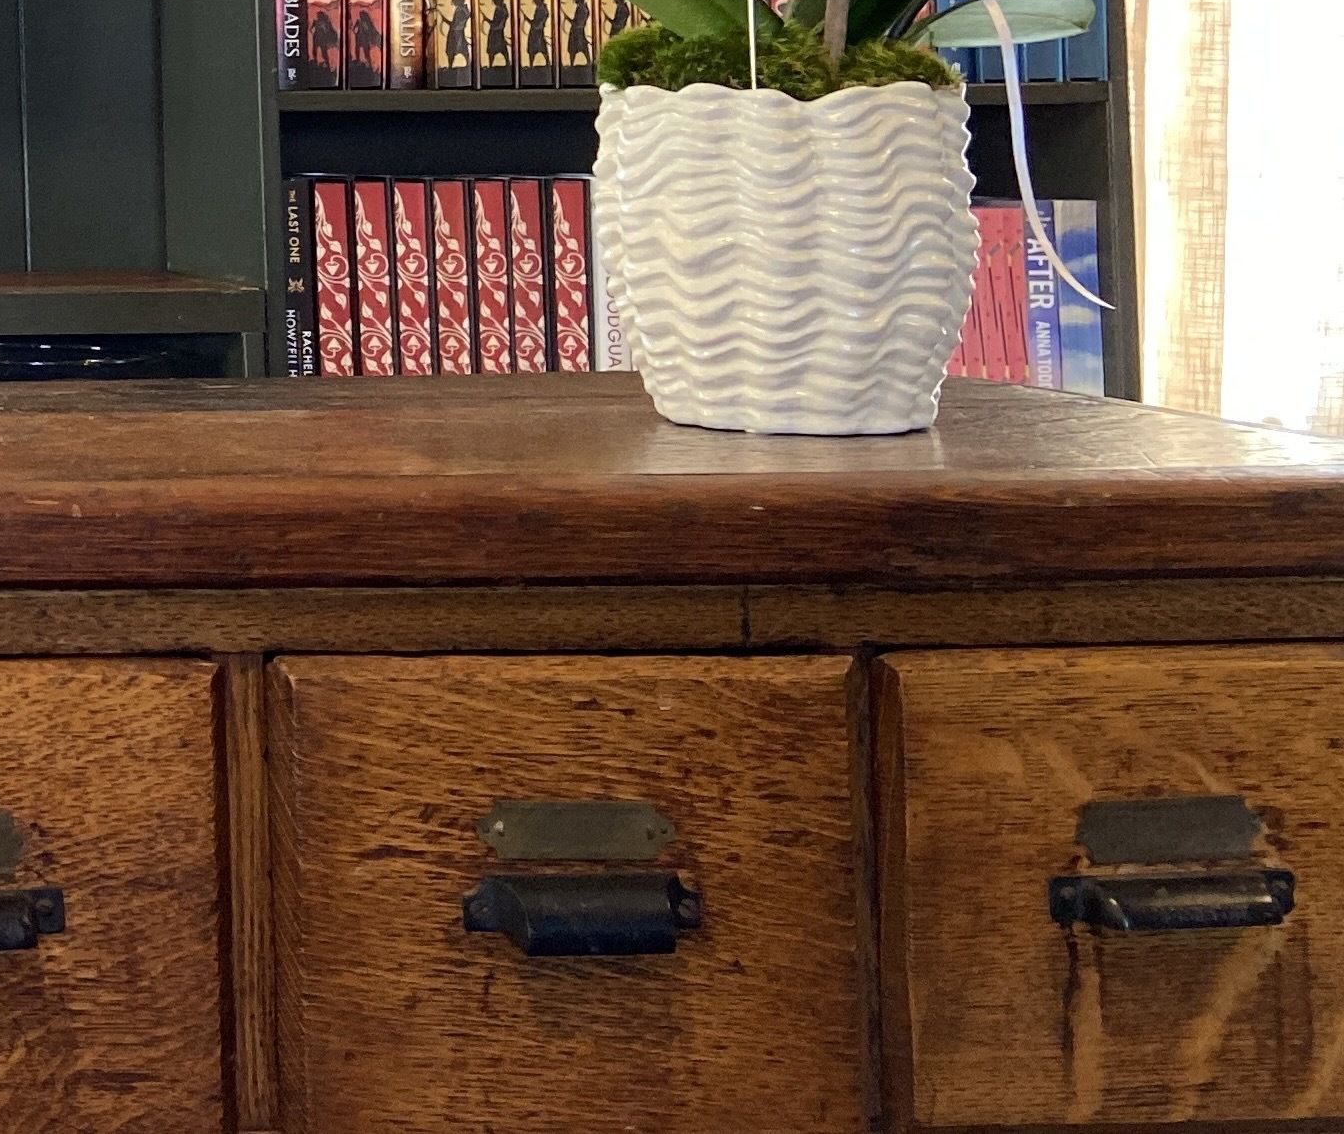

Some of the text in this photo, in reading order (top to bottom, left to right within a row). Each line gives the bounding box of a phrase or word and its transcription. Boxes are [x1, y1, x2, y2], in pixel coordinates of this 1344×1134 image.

[287, 188, 301, 264] THE LAST ONE
[301, 329, 314, 377] RACHEL
[1035, 320, 1051, 355] ANNA
